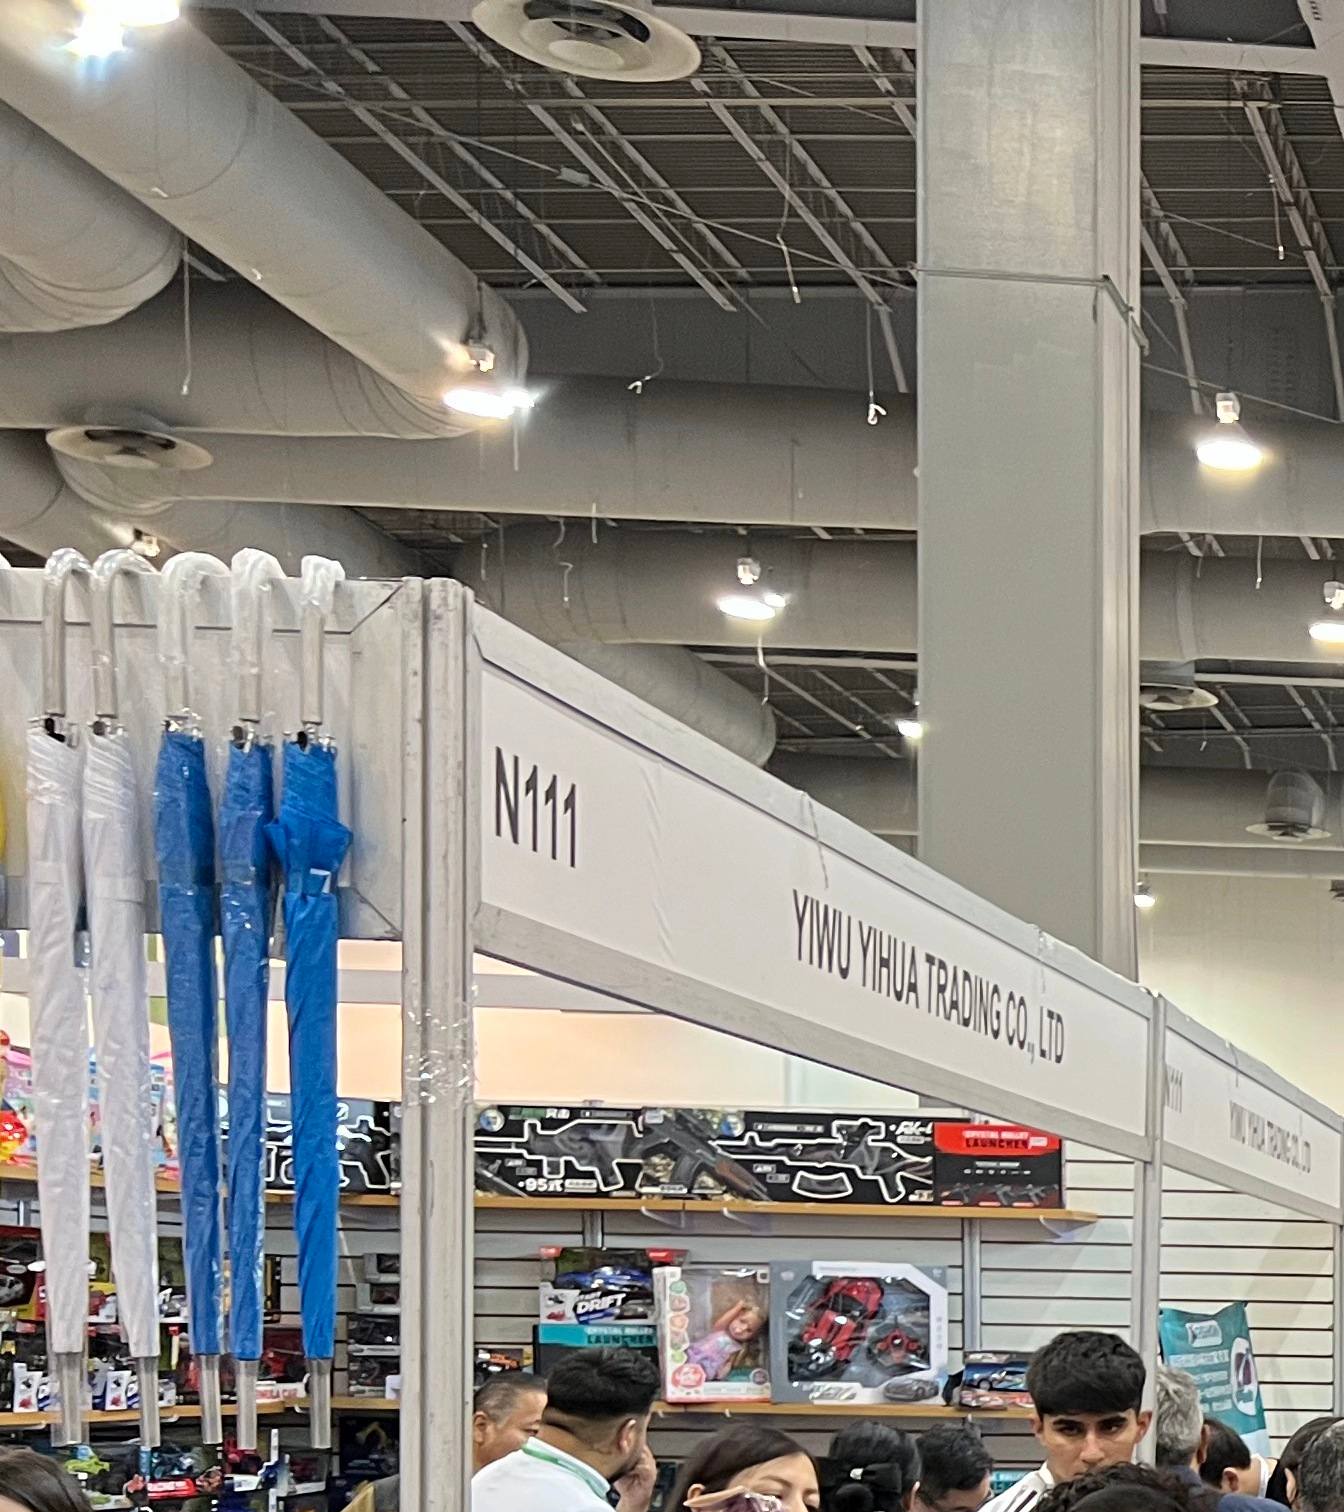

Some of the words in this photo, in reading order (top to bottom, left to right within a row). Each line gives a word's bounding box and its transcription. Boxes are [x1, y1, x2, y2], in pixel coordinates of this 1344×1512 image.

[495, 746, 576, 868] N111
[793, 888, 851, 979] YIWU
[859, 920, 920, 1009] YIHUA
[925, 952, 1001, 1040] TRADING
[1006, 991, 1035, 1064] CO.,
[1039, 1006, 1065, 1064] LTD
[576, 1293, 627, 1315] DRIFT
